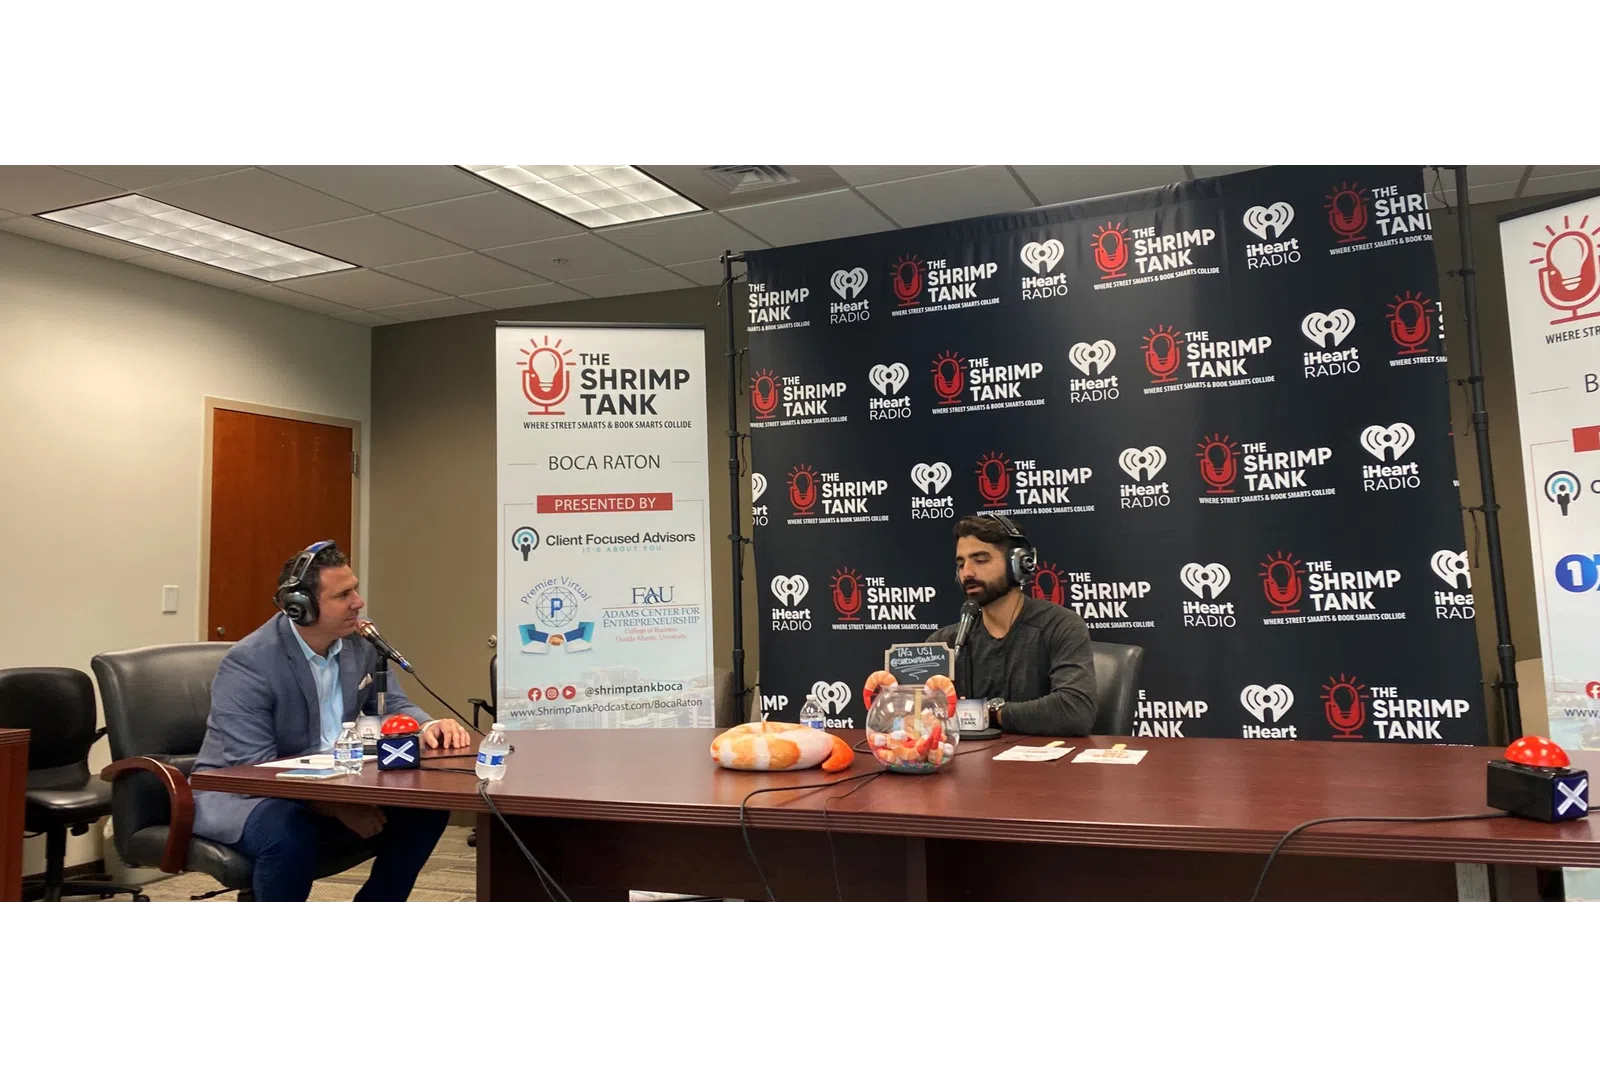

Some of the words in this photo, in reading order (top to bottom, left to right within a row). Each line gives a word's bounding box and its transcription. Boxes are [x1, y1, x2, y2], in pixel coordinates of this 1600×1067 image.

[1372, 185, 1398, 198] THE
[1133, 227, 1155, 239] THE
[1135, 229, 1215, 256] SHRIMP
[1246, 238, 1299, 257] iHeart
[927, 260, 946, 270] THE
[1135, 249, 1193, 274] TANK
[1247, 251, 1301, 269] RADIO
[928, 263, 998, 286] SHRIMP
[1022, 273, 1066, 288] iHeart
[1094, 282, 1112, 290] WHERE
[1113, 279, 1131, 287] STREET
[1133, 276, 1153, 285] SMARTS
[1160, 273, 1174, 281] BOOK
[1176, 270, 1197, 279] SMARTS
[1198, 267, 1219, 276] COLLIDE
[749, 288, 809, 307] SHRIMP
[928, 283, 977, 302] TANK
[1022, 285, 1068, 300] RADIO
[830, 300, 869, 313] iHeart
[962, 300, 980, 308] SMARTS
[749, 306, 790, 323] TANK
[830, 311, 870, 324] RADIO
[1185, 331, 1209, 342] THE
[1546, 329, 1581, 345] WHERE
[1187, 336, 1272, 360] SHRIMP
[580, 354, 610, 365] THE
[969, 358, 989, 367] THE
[1304, 347, 1358, 365] iHeart
[970, 363, 1043, 384] SHRIMP
[1187, 358, 1247, 378] TANK
[1304, 361, 1360, 379] RADIO
[581, 369, 690, 390] SHRIMP
[782, 376, 800, 385] THE
[1071, 376, 1118, 391] iHeart
[1144, 386, 1163, 394] WHERE
[1164, 384, 1183, 393] STREET
[1184, 382, 1206, 391] SMARTS
[1213, 380, 1228, 388] BOOK
[1229, 378, 1251, 386] SMARTS
[1253, 376, 1275, 384] COLLIDE
[783, 382, 847, 401] SHRIMP
[970, 382, 1021, 401] TANK
[1071, 388, 1119, 403] RADIO
[580, 394, 658, 415] TANK
[783, 401, 827, 416] TANK
[870, 396, 911, 409] iHeart
[870, 407, 911, 420] RADIO
[1242, 442, 1267, 453] THE
[549, 456, 598, 470] BOCA
[603, 455, 660, 469] RATON
[1015, 460, 1036, 470] THE
[1244, 447, 1332, 472] SHRIMP
[821, 473, 839, 482] THE
[1016, 467, 1092, 487] SHRIMP
[1363, 462, 1418, 478] iHeart
[1244, 470, 1307, 491] TANK
[1364, 476, 1421, 491] RADIO
[822, 480, 888, 498] SHRIMP
[1016, 487, 1070, 505] TANK
[1120, 482, 1169, 497] iHeart
[1199, 496, 1219, 504] WHERE
[1242, 493, 1264, 501] SMARTS
[1288, 490, 1311, 498] SMARTS
[1313, 488, 1335, 496] COLLIDE
[555, 498, 635, 511] PRESENTED
[640, 498, 656, 509] BY
[822, 498, 868, 514] TANK
[912, 496, 953, 508] iHeart
[1121, 495, 1170, 509] RADIO
[912, 507, 954, 519] RADIO
[546, 534, 582, 546] Client
[586, 533, 640, 545] Focused
[643, 532, 695, 543] Advisors
[1306, 561, 1332, 572] THE
[866, 577, 885, 586] THE
[1069, 573, 1091, 582] THE
[1309, 570, 1401, 591] SHRIMP
[521, 577, 557, 604] Premier
[561, 576, 592, 602] Virtual
[867, 587, 936, 603] SHRIMP
[1071, 581, 1151, 600] SHRIMP
[1072, 601, 1128, 618] TANK
[1183, 601, 1234, 614] iHeart
[1310, 592, 1376, 612] TANK
[603, 610, 639, 618] ADAMS
[641, 609, 679, 617] CENTER
[682, 607, 700, 615] FOR
[772, 609, 811, 619] iHeart
[868, 605, 916, 621] TANK
[604, 616, 700, 627] ENTREPRENEURSHIP
[772, 621, 812, 631] RADIO
[1184, 615, 1236, 628] RADIO
[896, 648, 912, 657] TAG
[585, 682, 682, 697] @shrimptankboca
[1370, 687, 1398, 697] THE
[510, 698, 702, 717] www.ShrimpTankPodcast.com/BocaRaton
[1134, 701, 1208, 719] HRIMP
[1373, 699, 1470, 718] SHRIMP
[1243, 725, 1297, 739] iHeart
[1373, 721, 1442, 739] TANK
